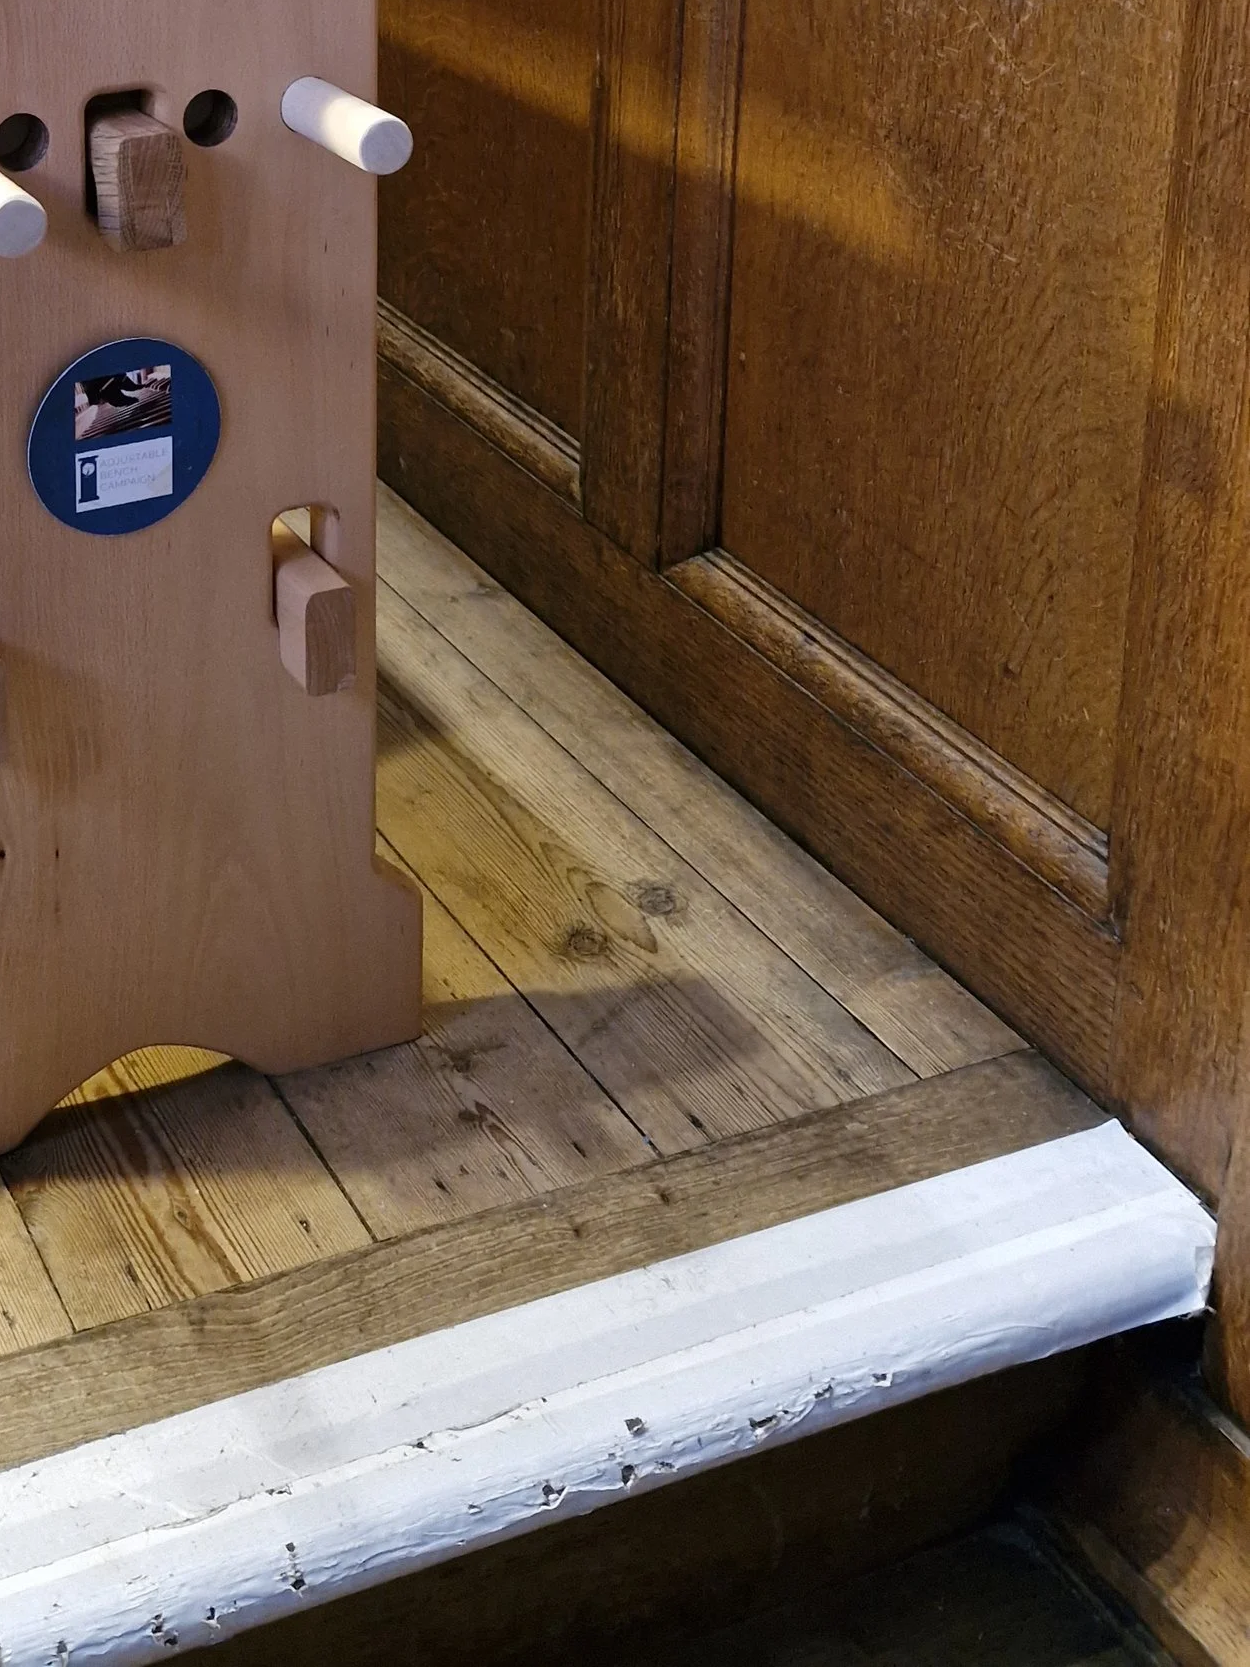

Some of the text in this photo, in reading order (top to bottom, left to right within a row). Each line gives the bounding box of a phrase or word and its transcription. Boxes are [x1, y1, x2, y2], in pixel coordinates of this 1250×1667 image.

[100, 447, 168, 467] ADJUSTABLE
[100, 466, 138, 480] BENCH
[100, 474, 156, 492] CAMPAIGN
